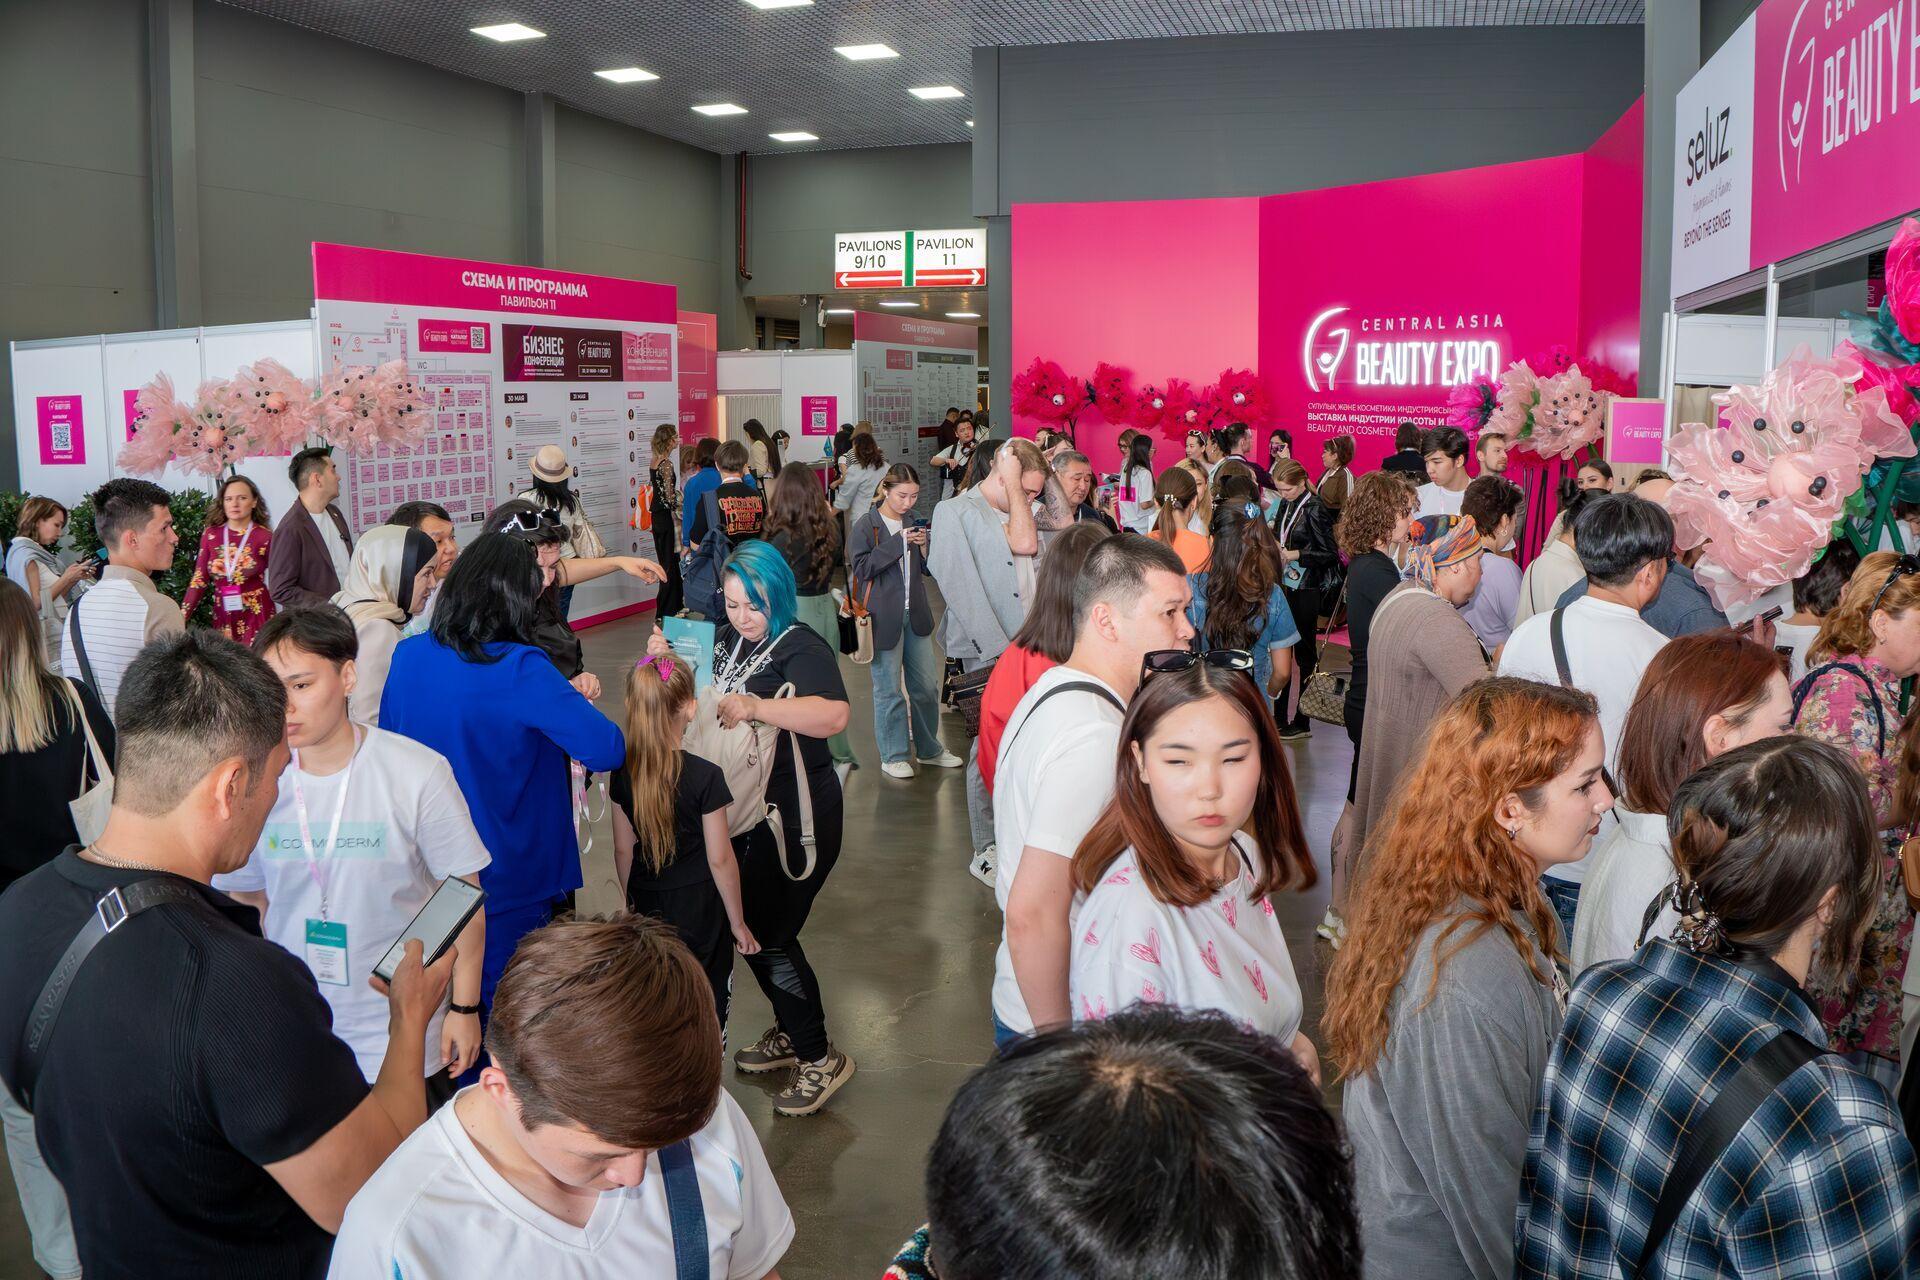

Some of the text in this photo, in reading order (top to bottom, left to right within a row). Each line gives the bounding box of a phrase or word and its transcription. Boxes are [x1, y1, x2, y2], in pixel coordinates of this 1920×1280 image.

[1822, 0, 1903, 154] BEAUTY
[1683, 208, 1731, 249] BEYOND THE SENSES
[838, 239, 902, 252] PAVILIONS
[916, 238, 974, 250] PAVILION
[854, 254, 886, 269] 9/10
[943, 253, 956, 266] 11
[461, 270, 589, 298] СХЕМА И ПРОГРАММА
[500, 295, 556, 310] ПАВИЛЬОН 11
[1361, 313, 1503, 331] CENTRAL ASIA
[523, 335, 564, 355] БИЗНЕС
[587, 347, 612, 359] BEAUTY EXPO
[417, 361, 428, 369] WC
[524, 355, 565, 367] КОНФЕРЕНЦИЯ
[1356, 340, 1500, 386] BEAUTY EXPO
[1357, 404, 1396, 413] КОСМЕТИКА
[1307, 412, 1347, 422] ВЫСТАВКА
[1348, 414, 1396, 424] ИНДУСТРИИ
[1397, 416, 1437, 426] КРАСОТЫ
[1438, 418, 1445, 426] И
[1307, 423, 1337, 432] BEAUTY
[1337, 425, 1355, 434] AND
[280, 837, 380, 849] COMDERM
